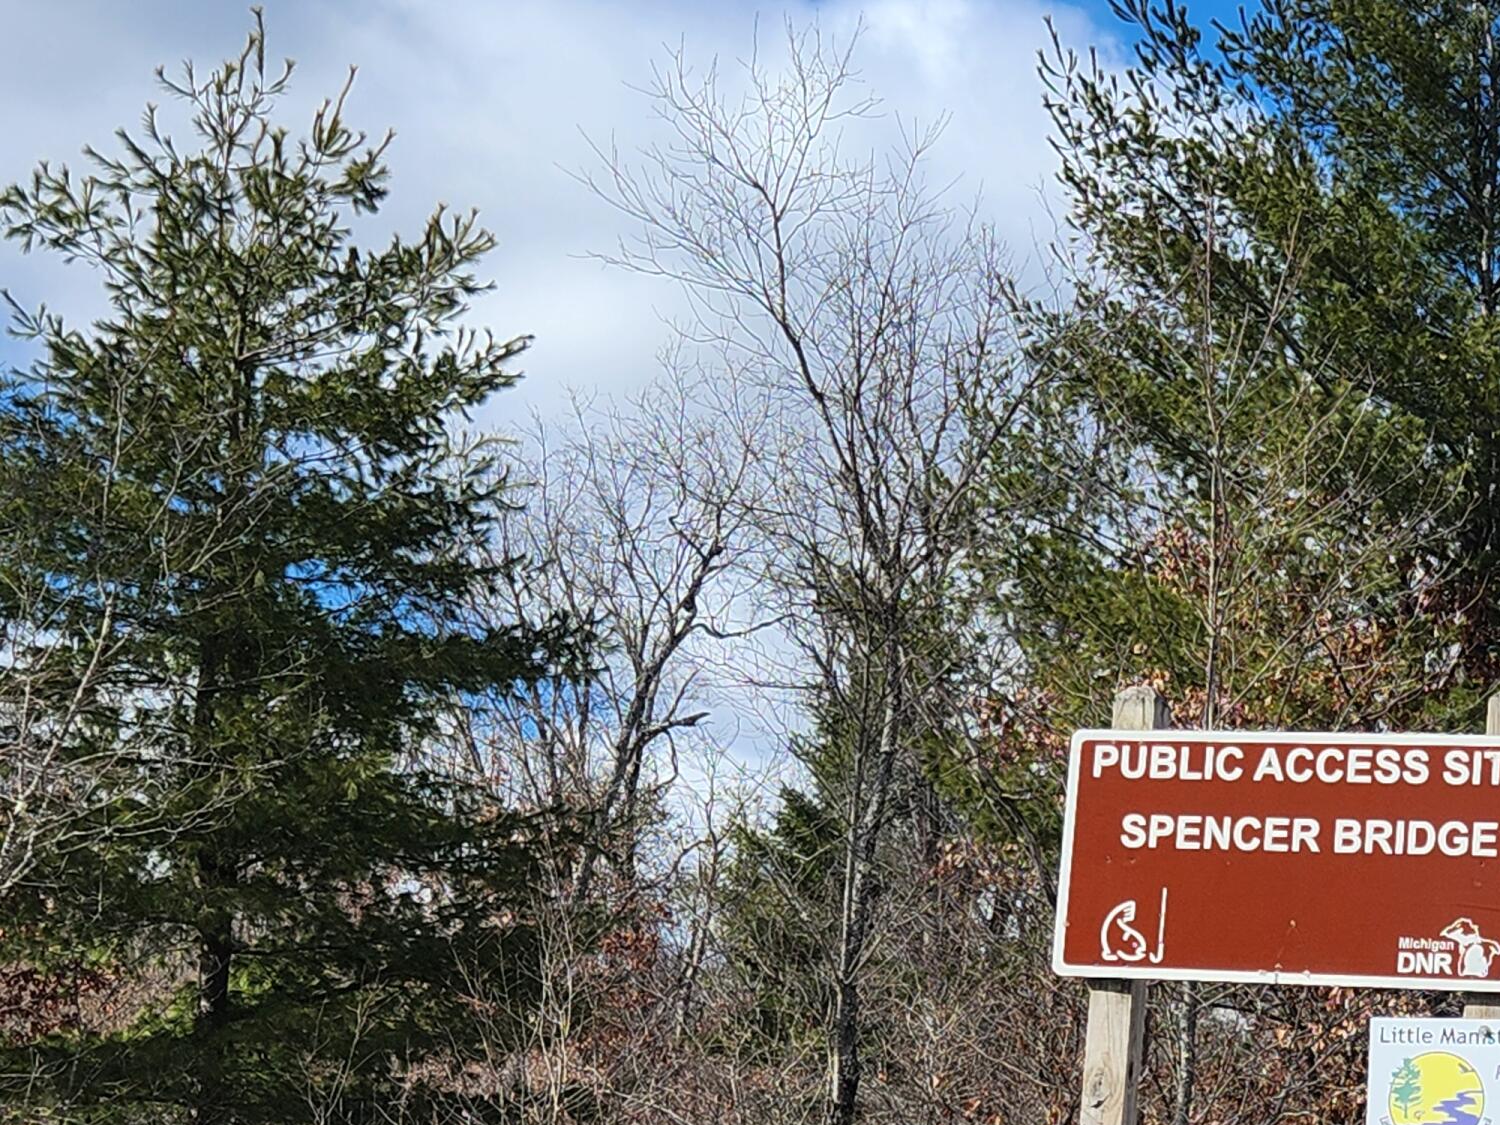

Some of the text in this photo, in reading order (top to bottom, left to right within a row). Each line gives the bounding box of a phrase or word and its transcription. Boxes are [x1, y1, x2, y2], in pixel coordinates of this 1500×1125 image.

[1092, 744, 1243, 781] PUBLIC
[1253, 746, 1429, 785] ACCESS
[1120, 813, 1499, 857] SPENCER BRIDGE
[1398, 937, 1455, 952] Michigan
[1397, 952, 1453, 975] DNR
[1380, 1026, 1433, 1044] Little
